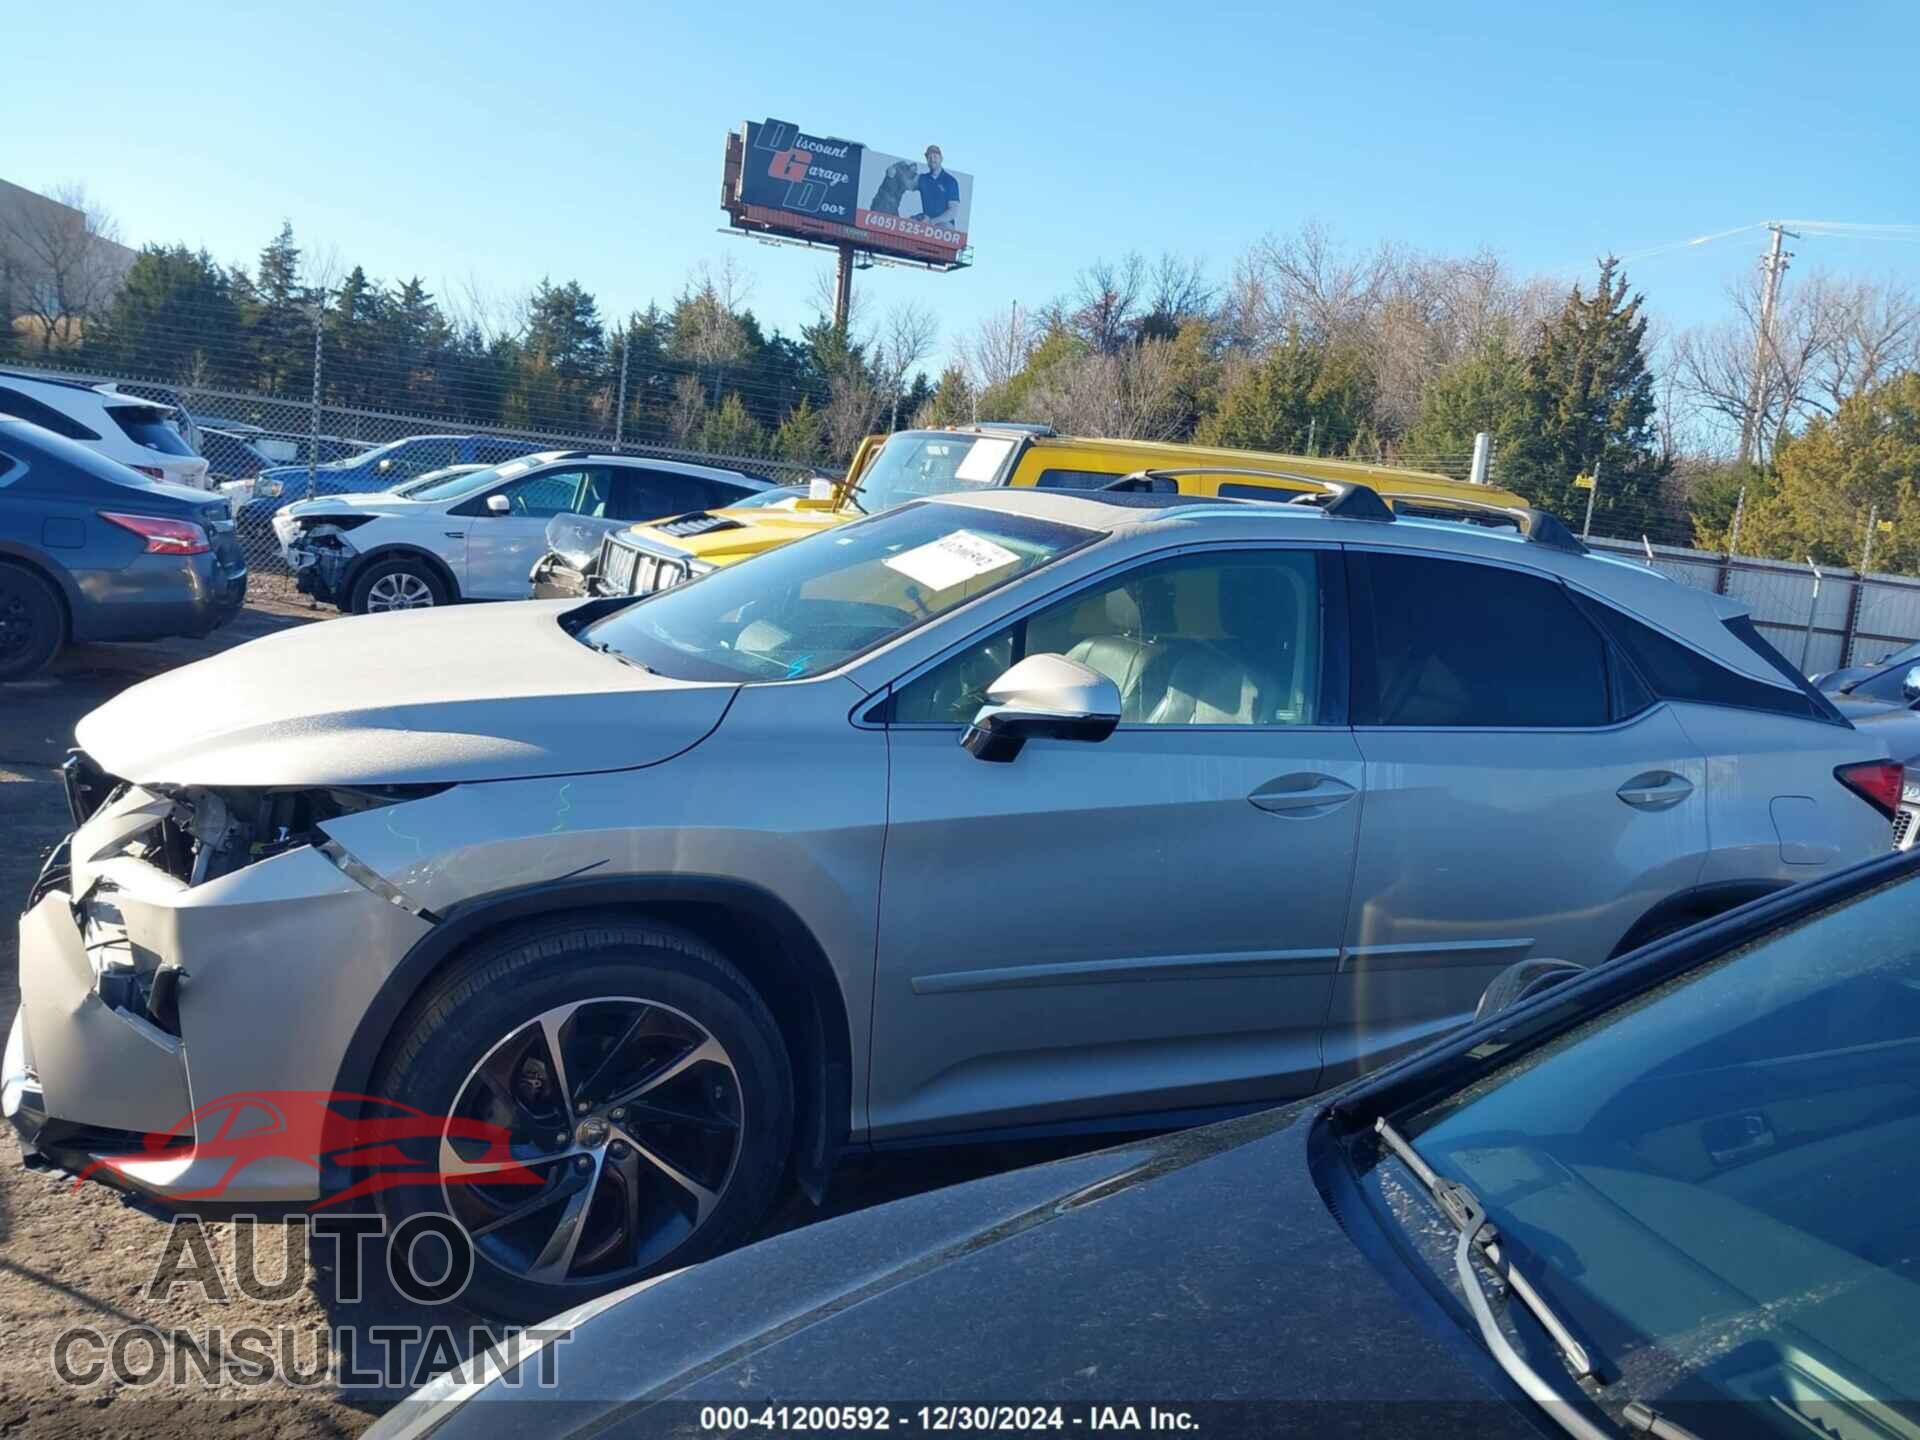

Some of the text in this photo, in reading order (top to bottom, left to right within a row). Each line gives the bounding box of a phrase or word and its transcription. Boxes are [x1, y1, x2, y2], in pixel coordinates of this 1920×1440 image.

[754, 117, 848, 158] Discount
[768, 147, 848, 186] Garage
[782, 178, 846, 215] Door
[864, 213, 961, 244] (405) 525-DOOR
